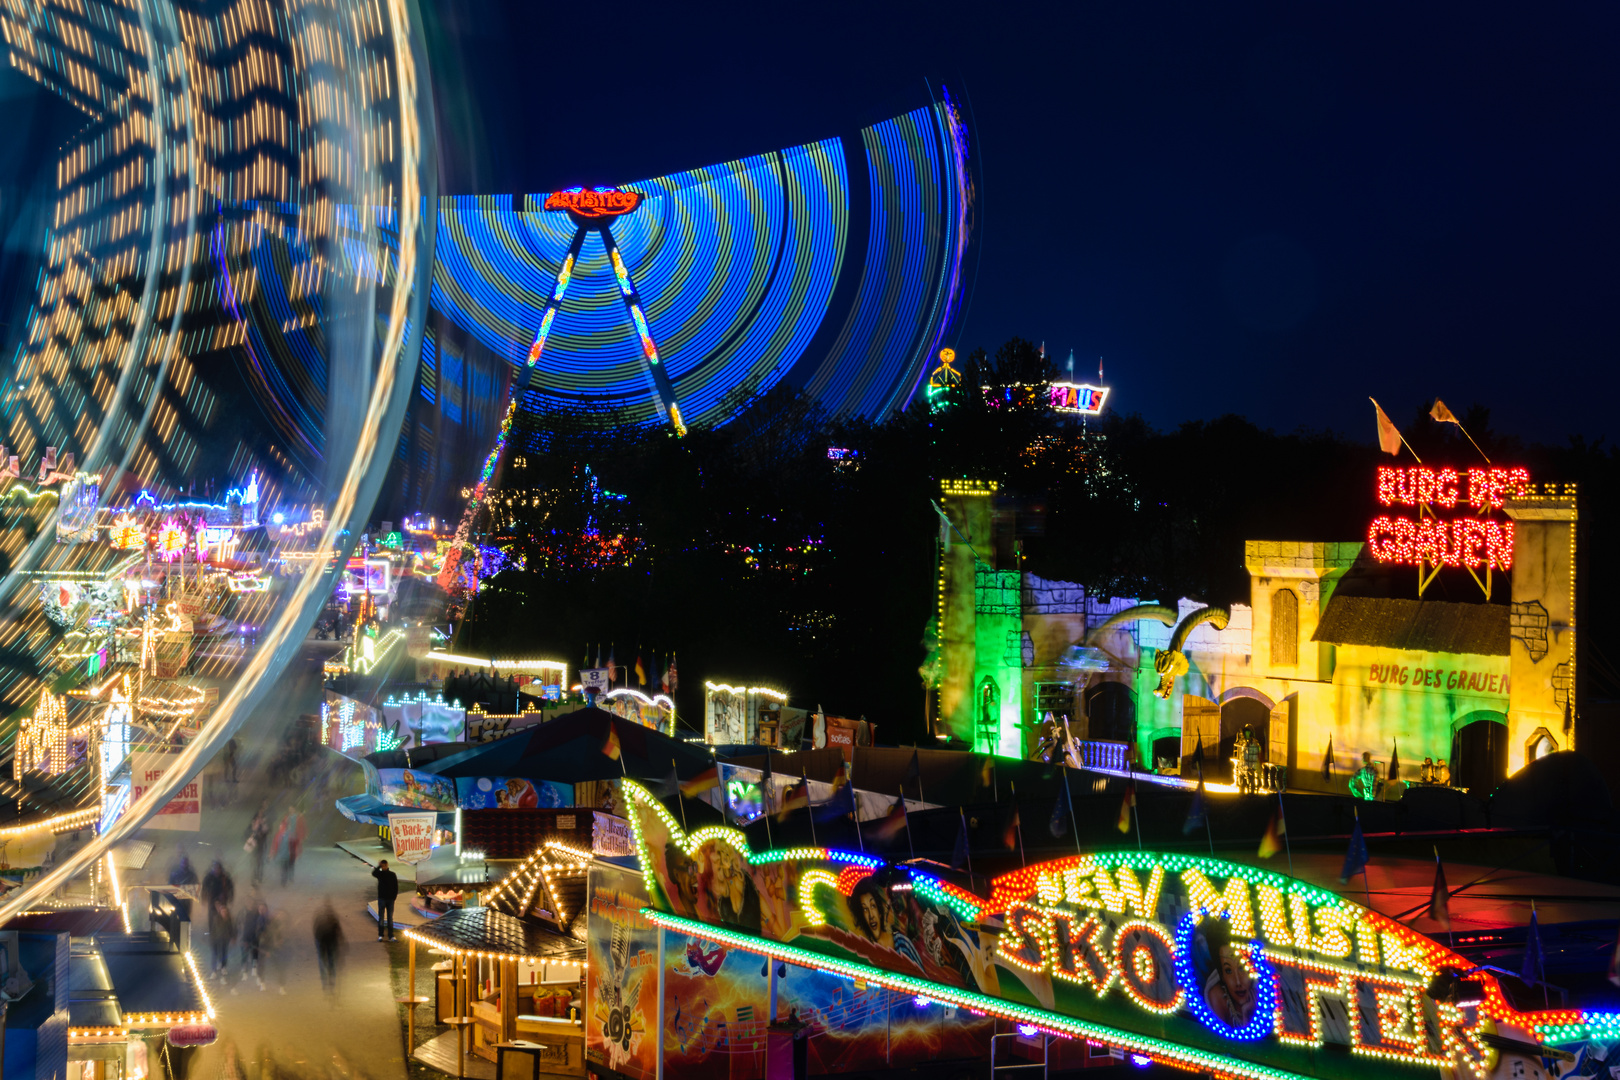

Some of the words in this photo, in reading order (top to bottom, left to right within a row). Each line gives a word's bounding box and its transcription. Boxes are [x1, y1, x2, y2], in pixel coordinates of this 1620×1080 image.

[1051, 386, 1103, 410] MAUS
[1378, 466, 1458, 507] BURG
[1369, 516, 1514, 569] GRAUEN
[590, 671, 600, 681] 8
[1369, 664, 1409, 685] BURG
[1412, 668, 1444, 688] DES
[1447, 670, 1511, 694] GRAUEN
[469, 718, 509, 738] TOY
[1035, 863, 1164, 919] NEW
[1181, 866, 1434, 976] MUSIK
[996, 900, 1491, 1079] SKOOTER
